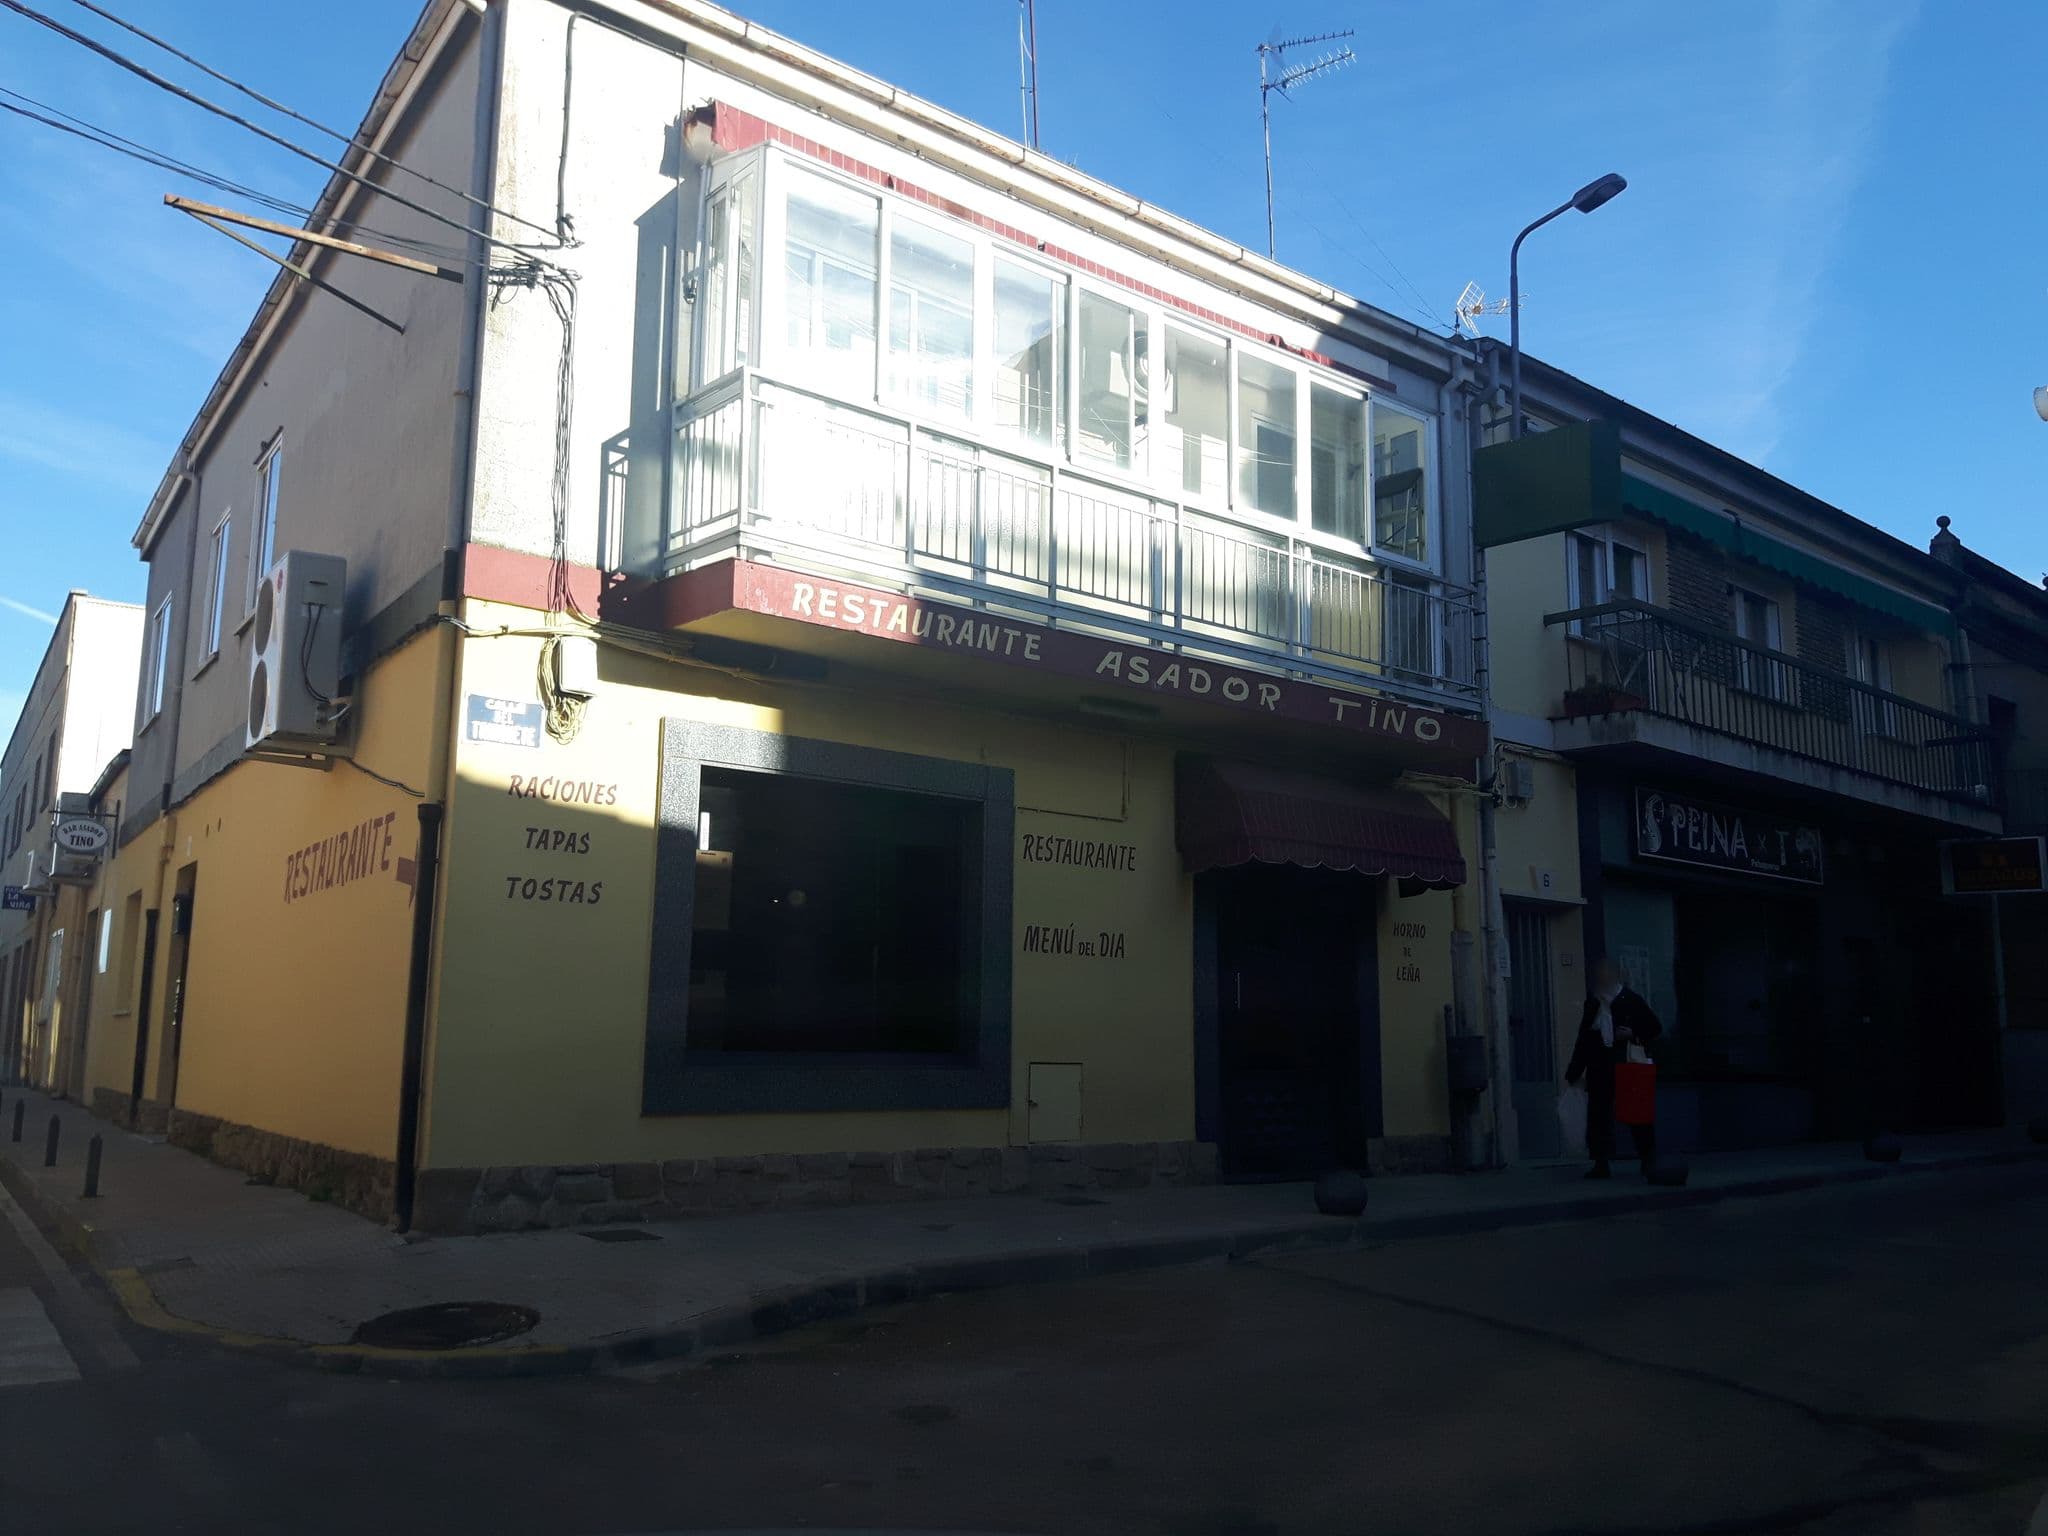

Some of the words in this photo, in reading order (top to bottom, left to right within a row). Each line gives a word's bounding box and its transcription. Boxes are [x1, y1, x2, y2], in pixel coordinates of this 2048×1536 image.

[791, 583, 1042, 662] RESTAURANTE
[1096, 651, 1281, 712] ASADOR
[508, 775, 618, 806] RACIONES
[62, 824, 77, 834] BAR
[79, 824, 104, 838] ASADOR
[70, 834, 94, 847] TINO
[525, 827, 590, 854] TAPAS
[283, 811, 396, 905] RESTAURANTE
[1022, 833, 1137, 871] RESTAURANTE
[506, 877, 603, 905] TOSTAS
[1024, 922, 1075, 954] MENÚ
[1078, 941, 1096, 957] DEL
[1099, 932, 1125, 959] DIA
[1393, 921, 1426, 938] HORNO
[1396, 963, 1421, 982] LEÑA
